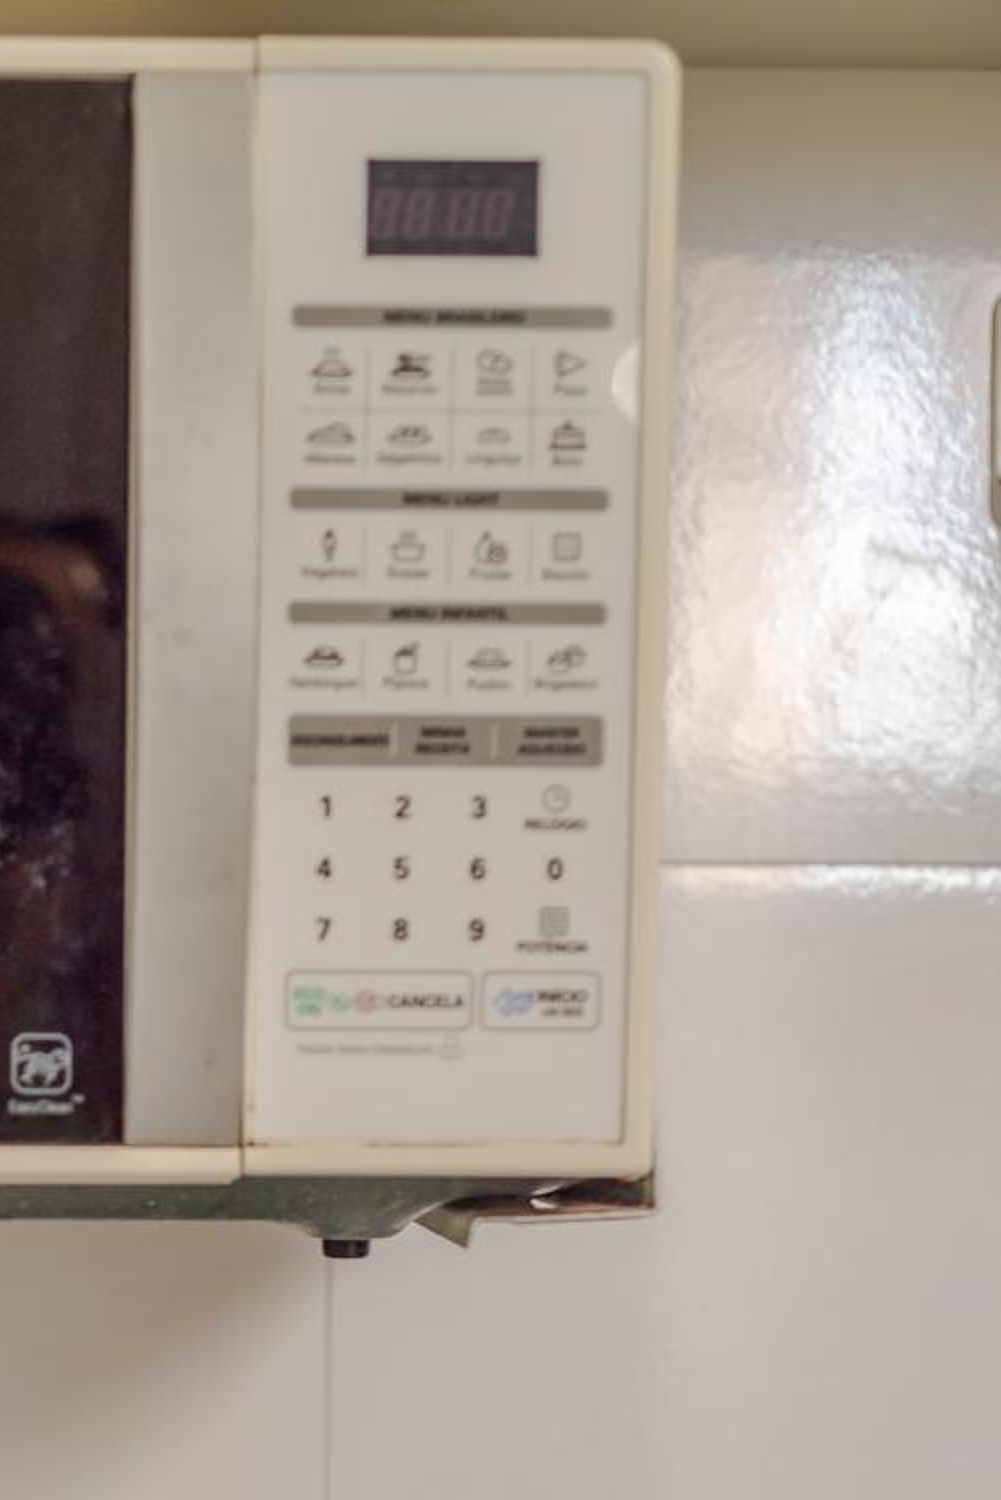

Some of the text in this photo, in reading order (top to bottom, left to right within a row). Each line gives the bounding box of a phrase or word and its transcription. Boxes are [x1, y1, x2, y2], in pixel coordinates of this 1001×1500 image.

[320, 795, 332, 819] 1
[395, 795, 411, 820] 2
[471, 796, 487, 820] 3
[316, 857, 332, 880] 4
[394, 856, 410, 881] 5
[470, 857, 486, 881] 6
[547, 857, 563, 881] 0
[316, 917, 332, 942] 7
[393, 918, 409, 942] 8
[469, 918, 485, 942] 9
[387, 994, 464, 1008] CANCELA
